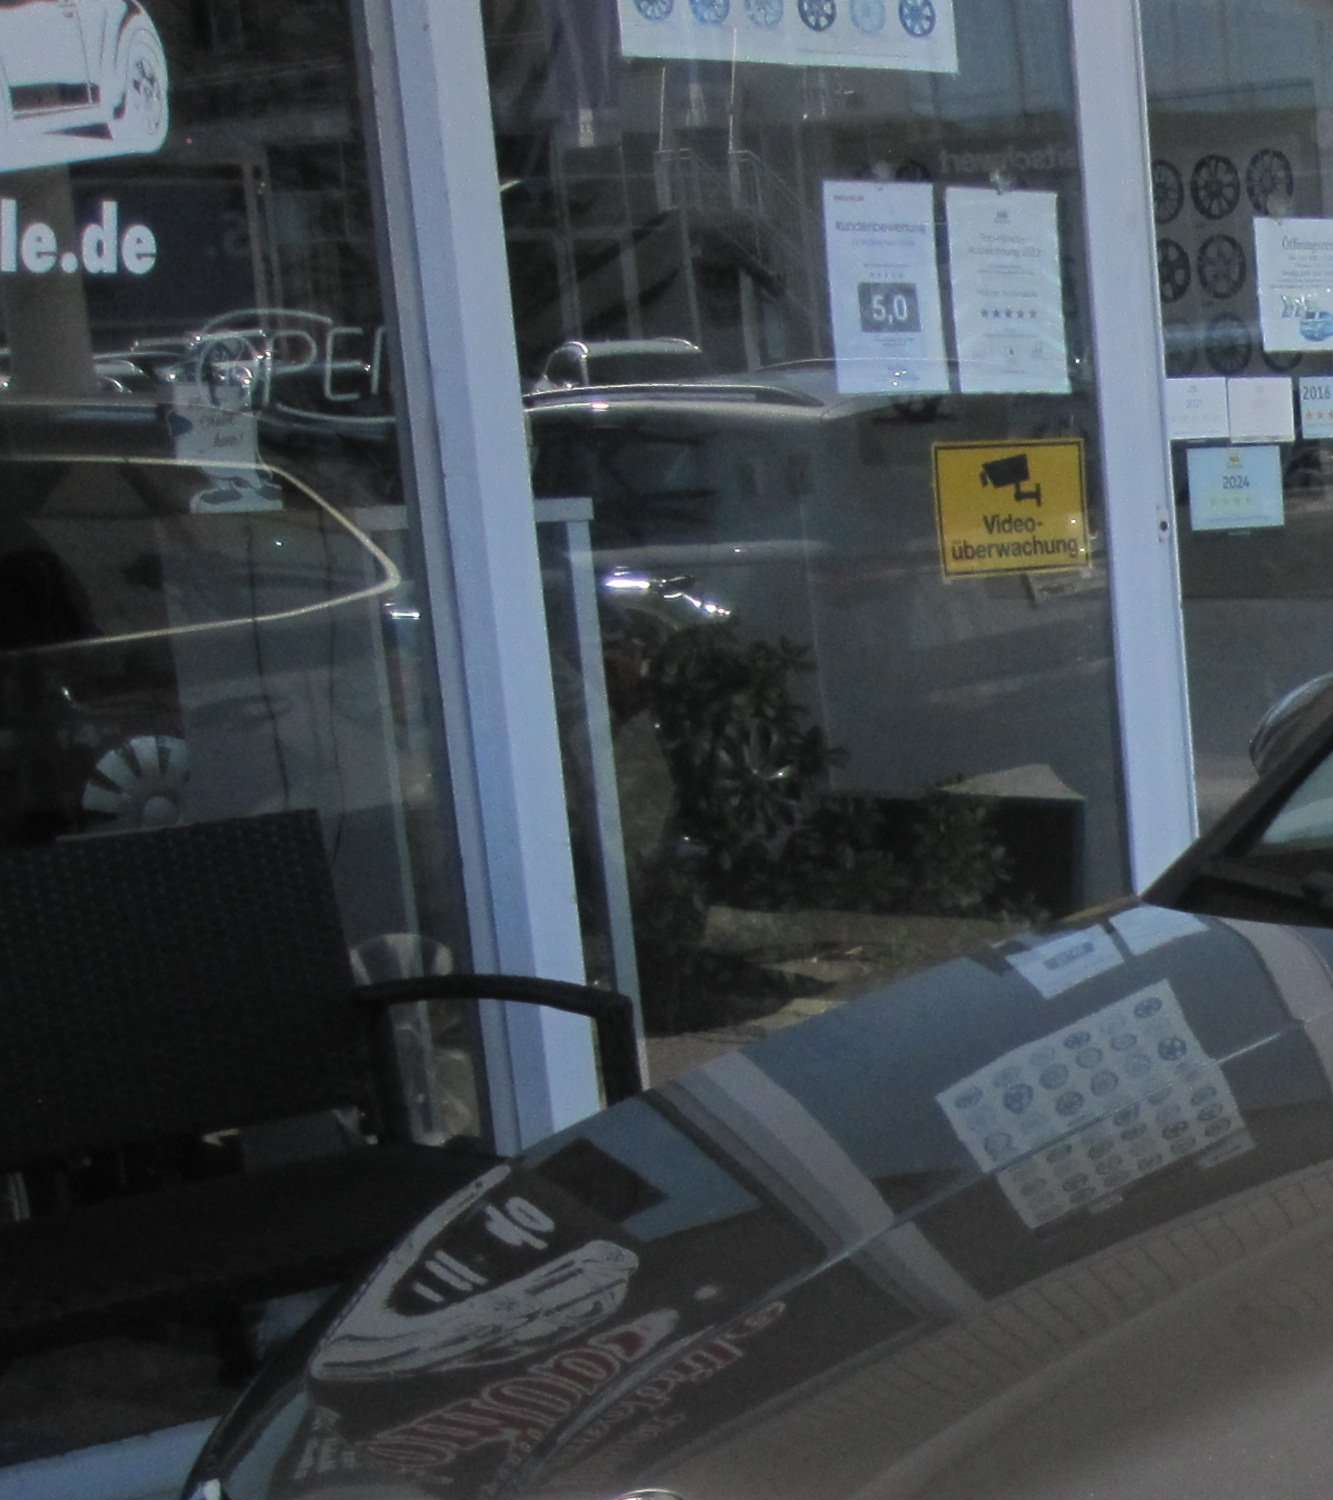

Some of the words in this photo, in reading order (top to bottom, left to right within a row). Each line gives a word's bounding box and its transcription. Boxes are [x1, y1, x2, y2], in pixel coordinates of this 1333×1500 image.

[0, 198, 158, 275] le.de
[870, 293, 909, 325] 5,0
[1222, 474, 1250, 489] 2024
[983, 514, 1044, 536] Video-
[951, 535, 1079, 561] überwachung
